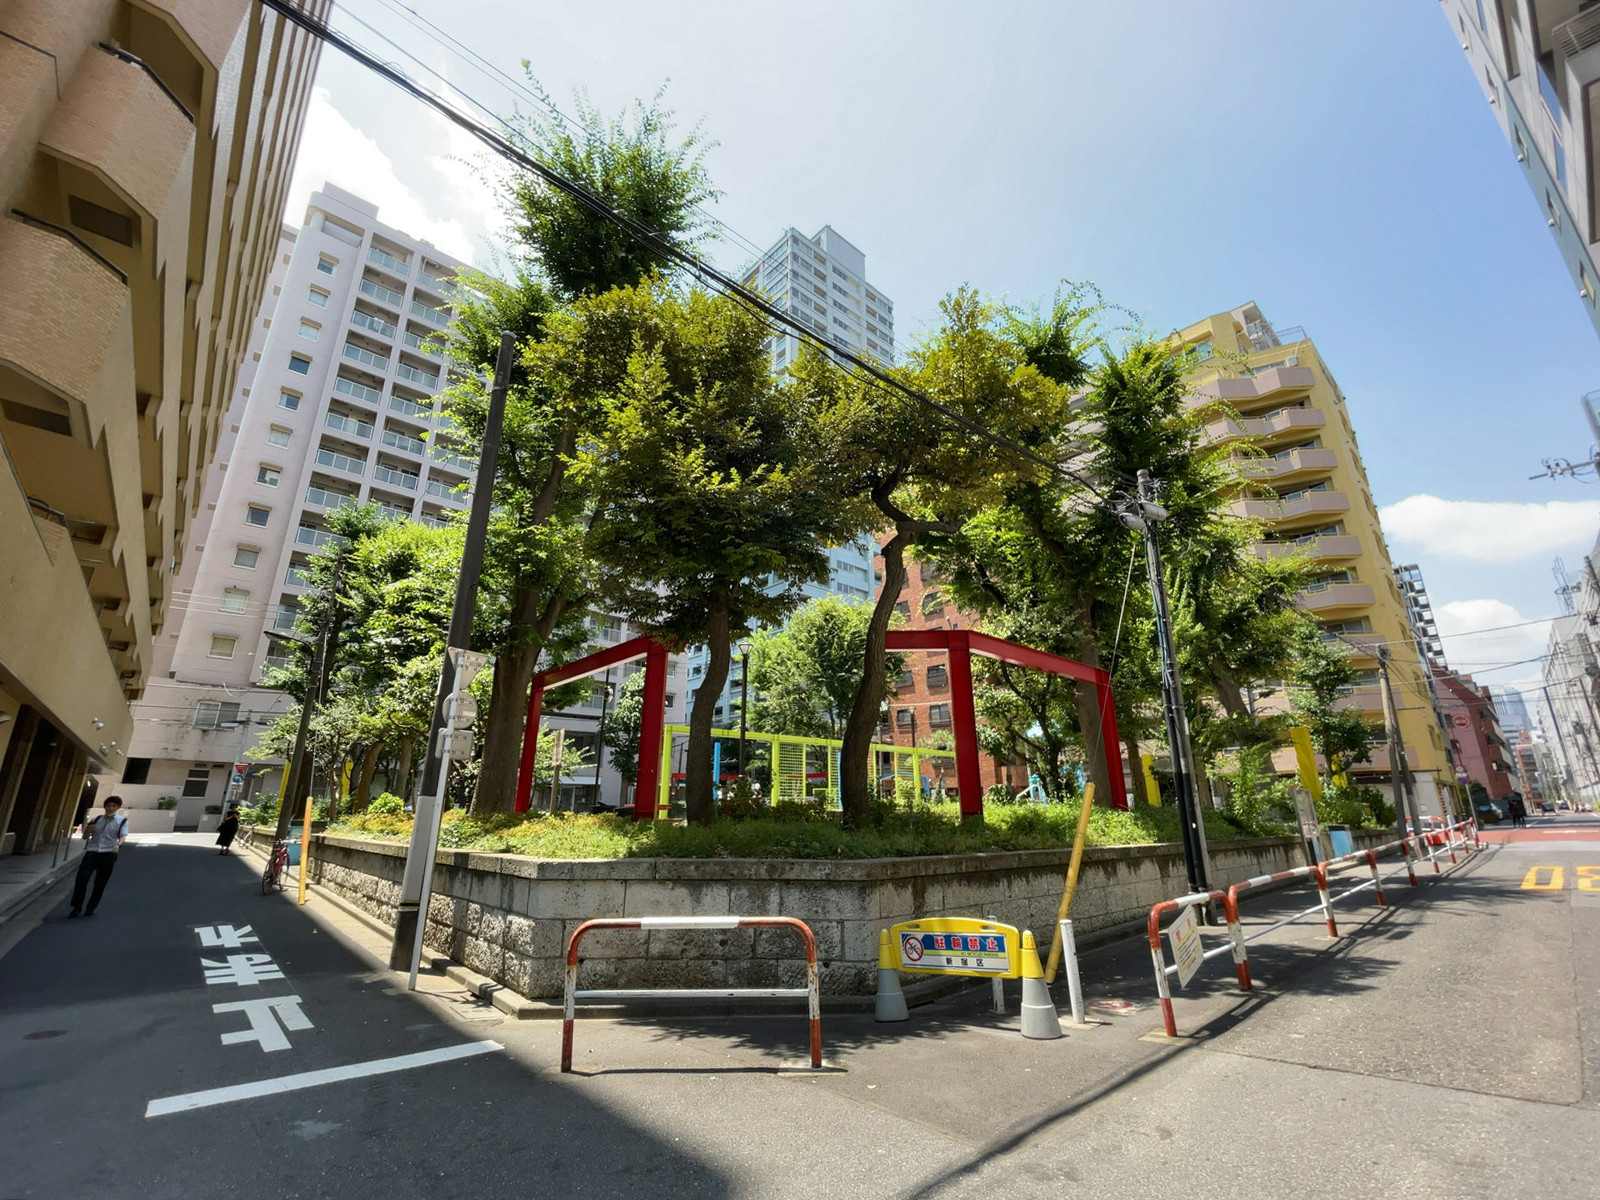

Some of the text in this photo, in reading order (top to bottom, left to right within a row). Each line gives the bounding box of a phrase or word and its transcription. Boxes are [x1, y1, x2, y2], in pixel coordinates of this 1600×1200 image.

[933, 936, 999, 951] 駐輪禁止
[945, 957, 984, 967] 新宿区
[194, 924, 315, 1053] 止まれ
